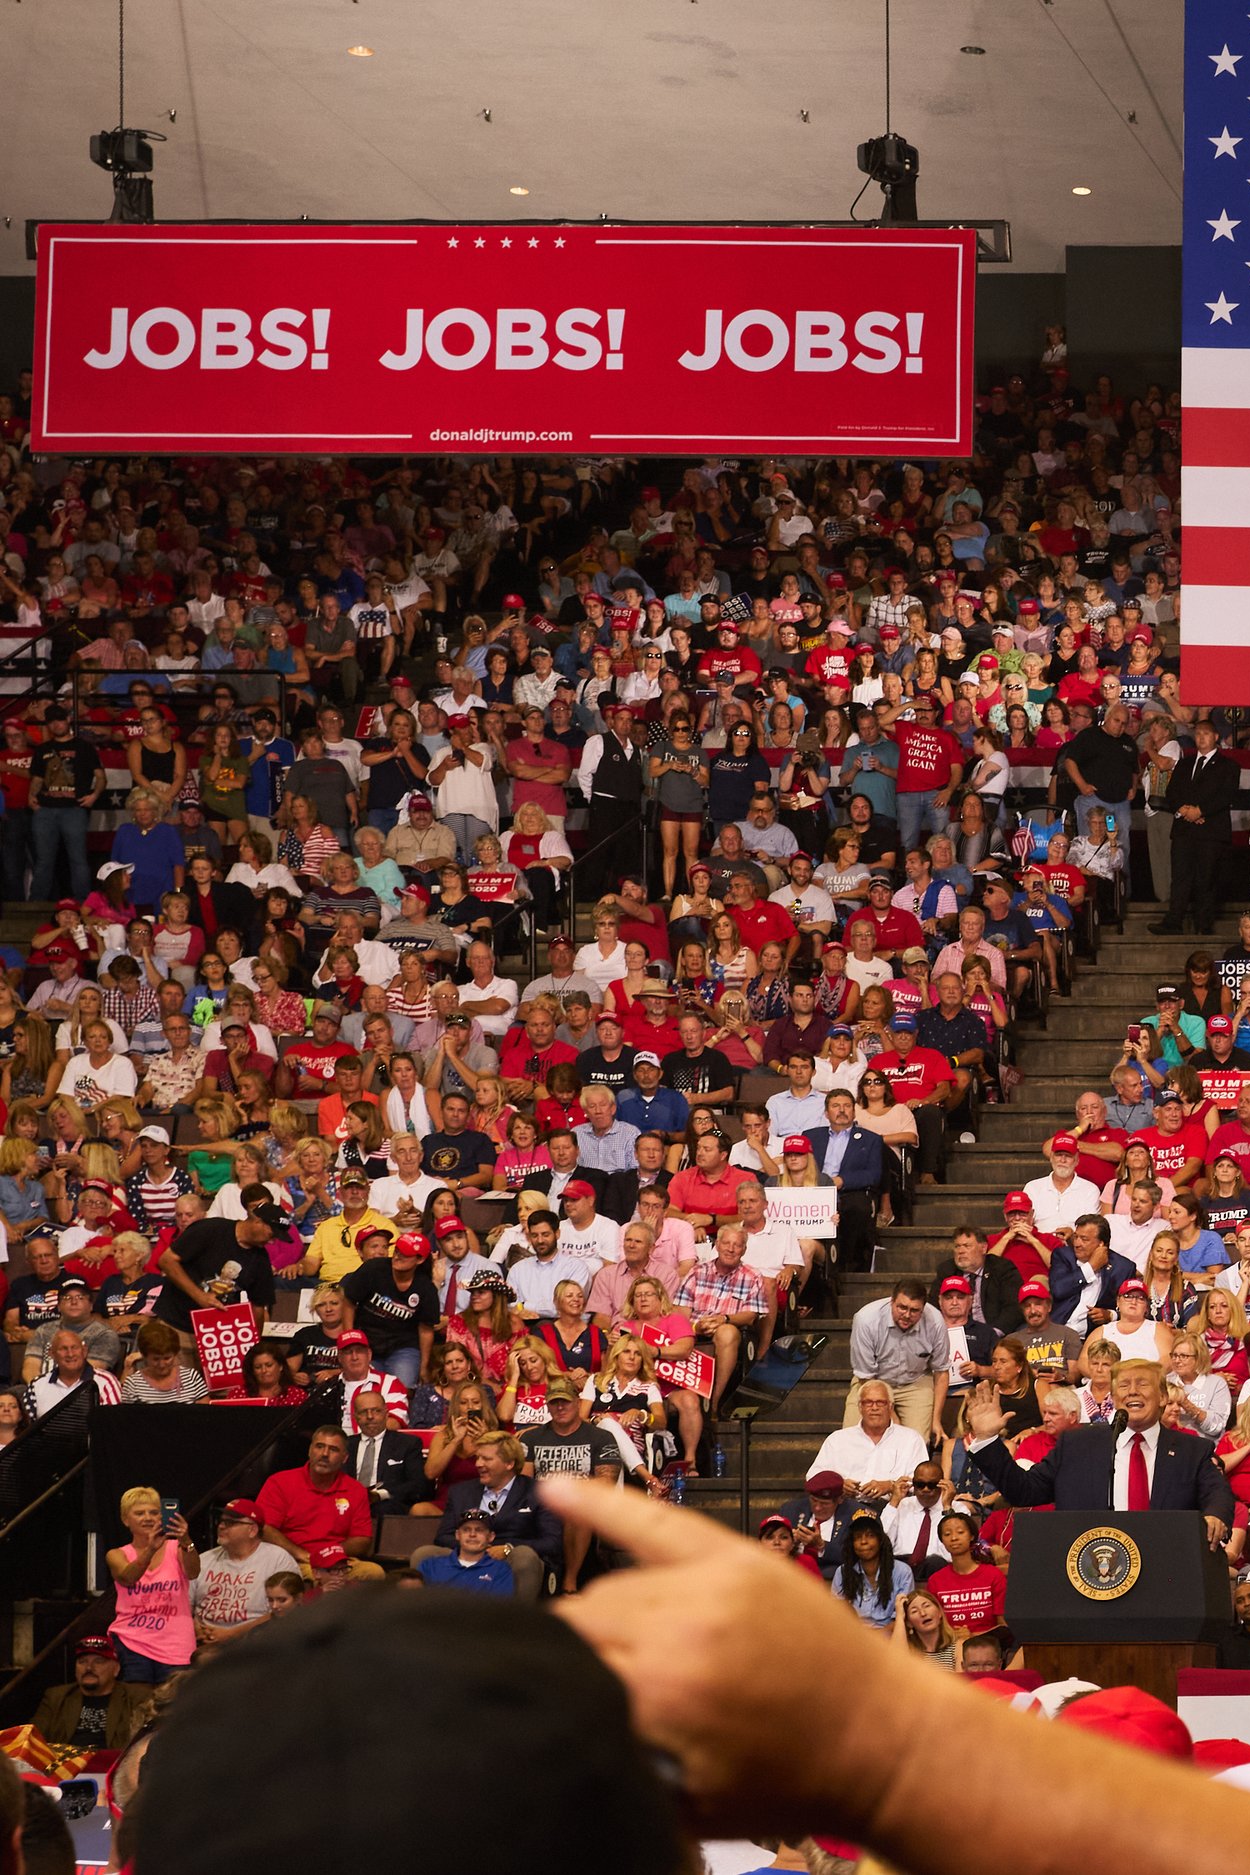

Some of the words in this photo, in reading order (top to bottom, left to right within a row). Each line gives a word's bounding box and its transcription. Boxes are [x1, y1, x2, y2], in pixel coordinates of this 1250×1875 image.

[83, 306, 331, 371] JOBS!
[379, 307, 625, 371] JOBS!
[677, 308, 924, 374] JOBS!
[429, 426, 573, 444] donaldjtrump.com
[605, 608, 632, 618] OBS!
[1120, 685, 1155, 693] RUMP
[912, 731, 938, 743] MAKE
[904, 736, 943, 754] AMERICA
[907, 748, 938, 761] GREAT
[906, 760, 936, 771] AGAIN
[826, 876, 857, 886] RUMP
[591, 1072, 625, 1081] TRUMP
[1203, 1091, 1236, 1100] 2020
[1156, 1157, 1185, 1171] ENCE
[766, 1201, 831, 1218] Women
[561, 1241, 598, 1251] TRUMP
[200, 1322, 224, 1377] JOBS!
[217, 1320, 243, 1374] JOBS!
[1026, 1341, 1065, 1363] AVY
[533, 1445, 591, 1461] VETERANS
[541, 1459, 584, 1473] BEFORE
[205, 1569, 256, 1586] MAKE
[126, 1579, 181, 1596] Women
[199, 1598, 249, 1611] GREAT
[941, 1591, 992, 1604] TRUMP
[128, 1614, 166, 1631] 2020
[952, 1614, 966, 1622] 20
[970, 1611, 985, 1620] 20
